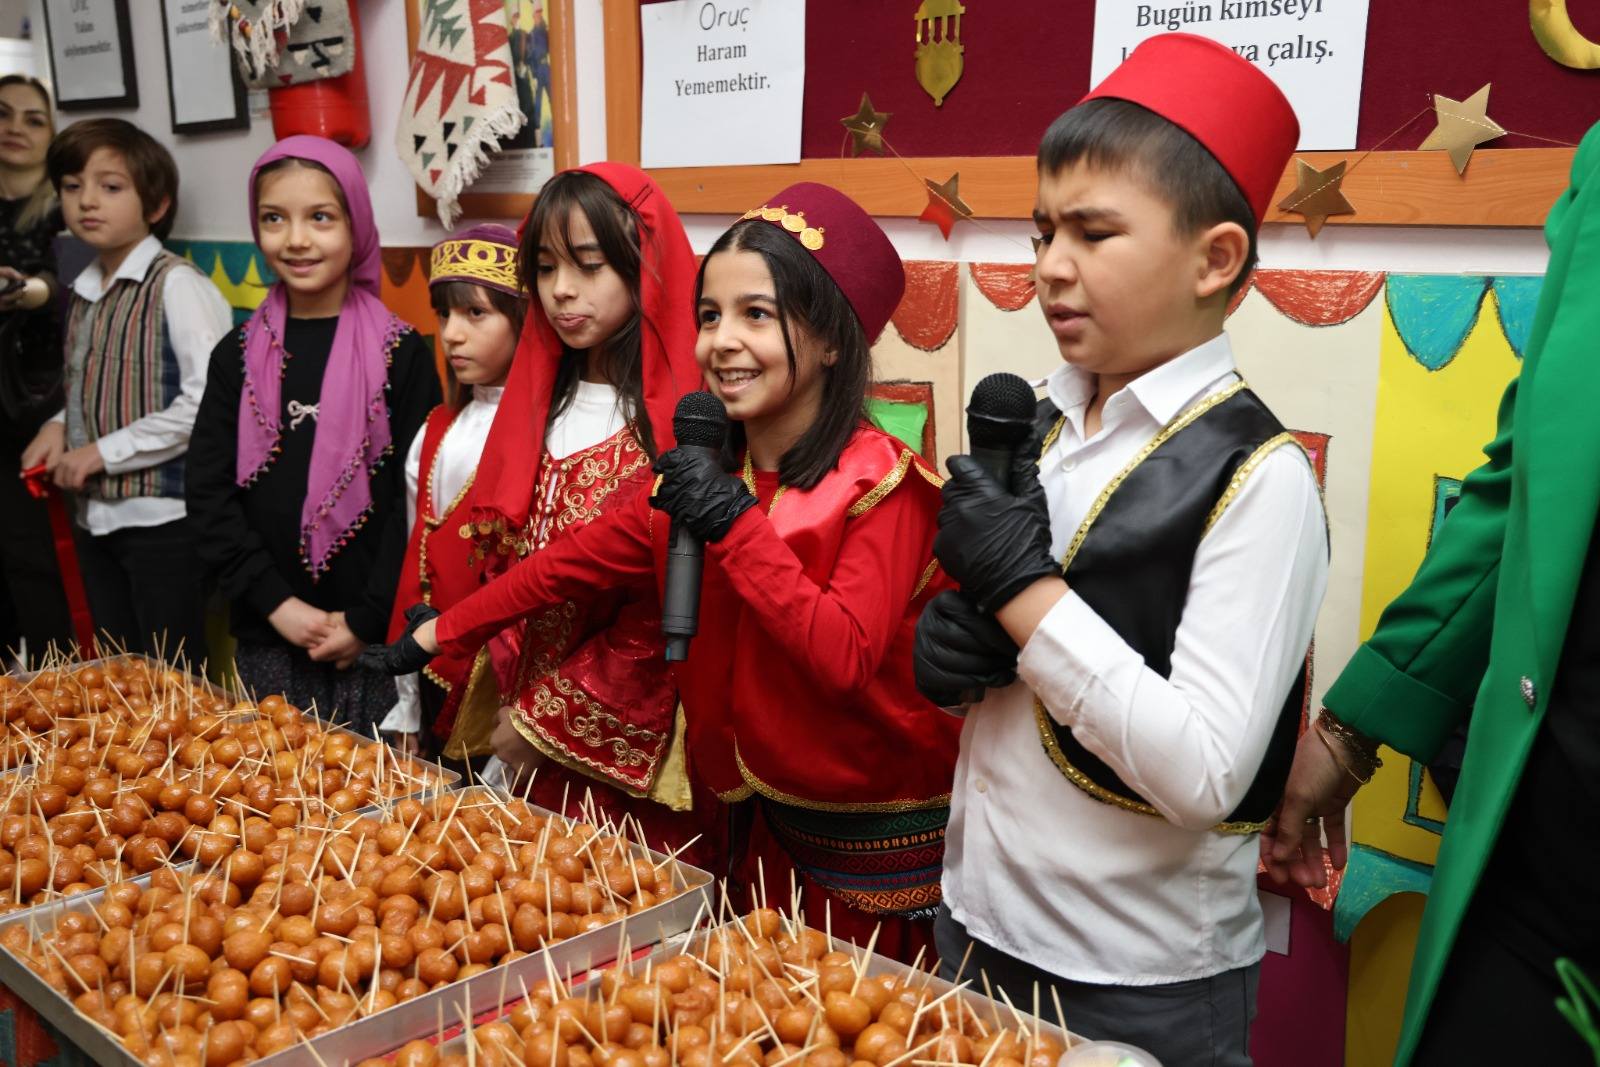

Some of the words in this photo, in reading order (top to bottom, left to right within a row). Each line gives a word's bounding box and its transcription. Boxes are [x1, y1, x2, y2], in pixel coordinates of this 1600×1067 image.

[700, 2, 750, 32] Oruç
[1136, 1, 1212, 31] Bugün
[697, 44, 747, 62] Haram
[1267, 34, 1334, 67] çalış.
[675, 72, 771, 97] Yememektir.
